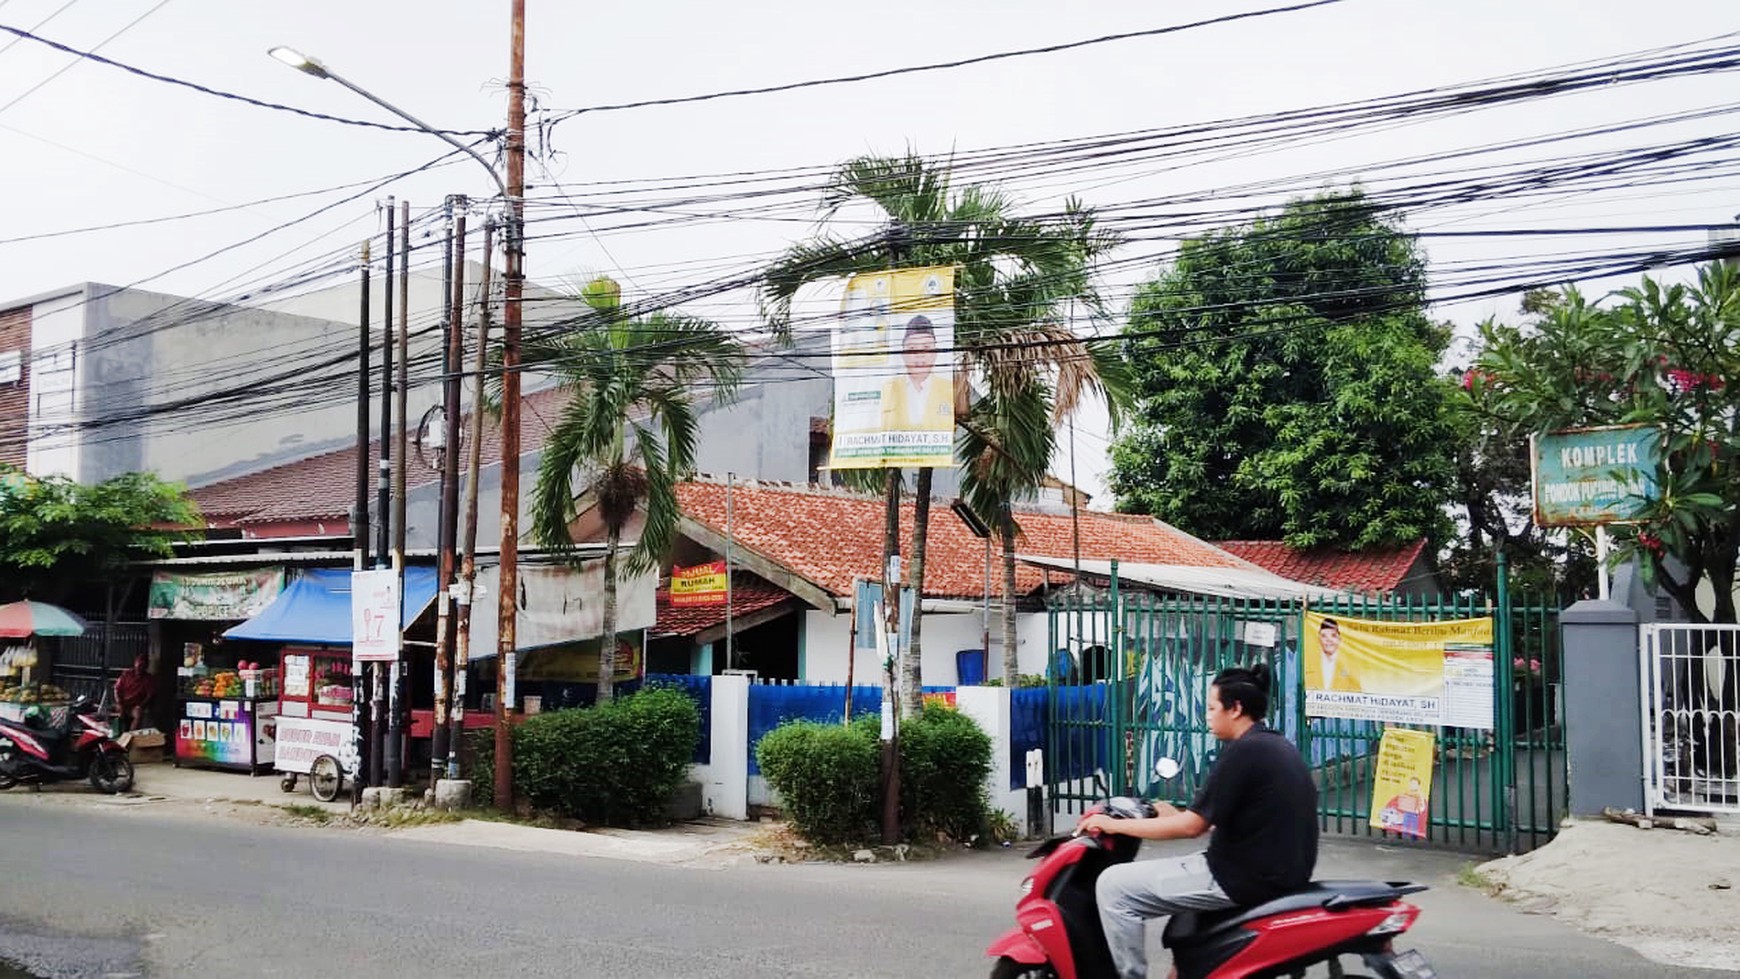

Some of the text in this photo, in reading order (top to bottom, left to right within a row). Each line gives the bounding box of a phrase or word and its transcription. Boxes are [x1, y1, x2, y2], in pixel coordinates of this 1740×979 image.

[1561, 443, 1638, 468] KOMPLEK
[681, 577, 715, 588] RUMAH
[1316, 693, 1368, 705] RACHMAT
